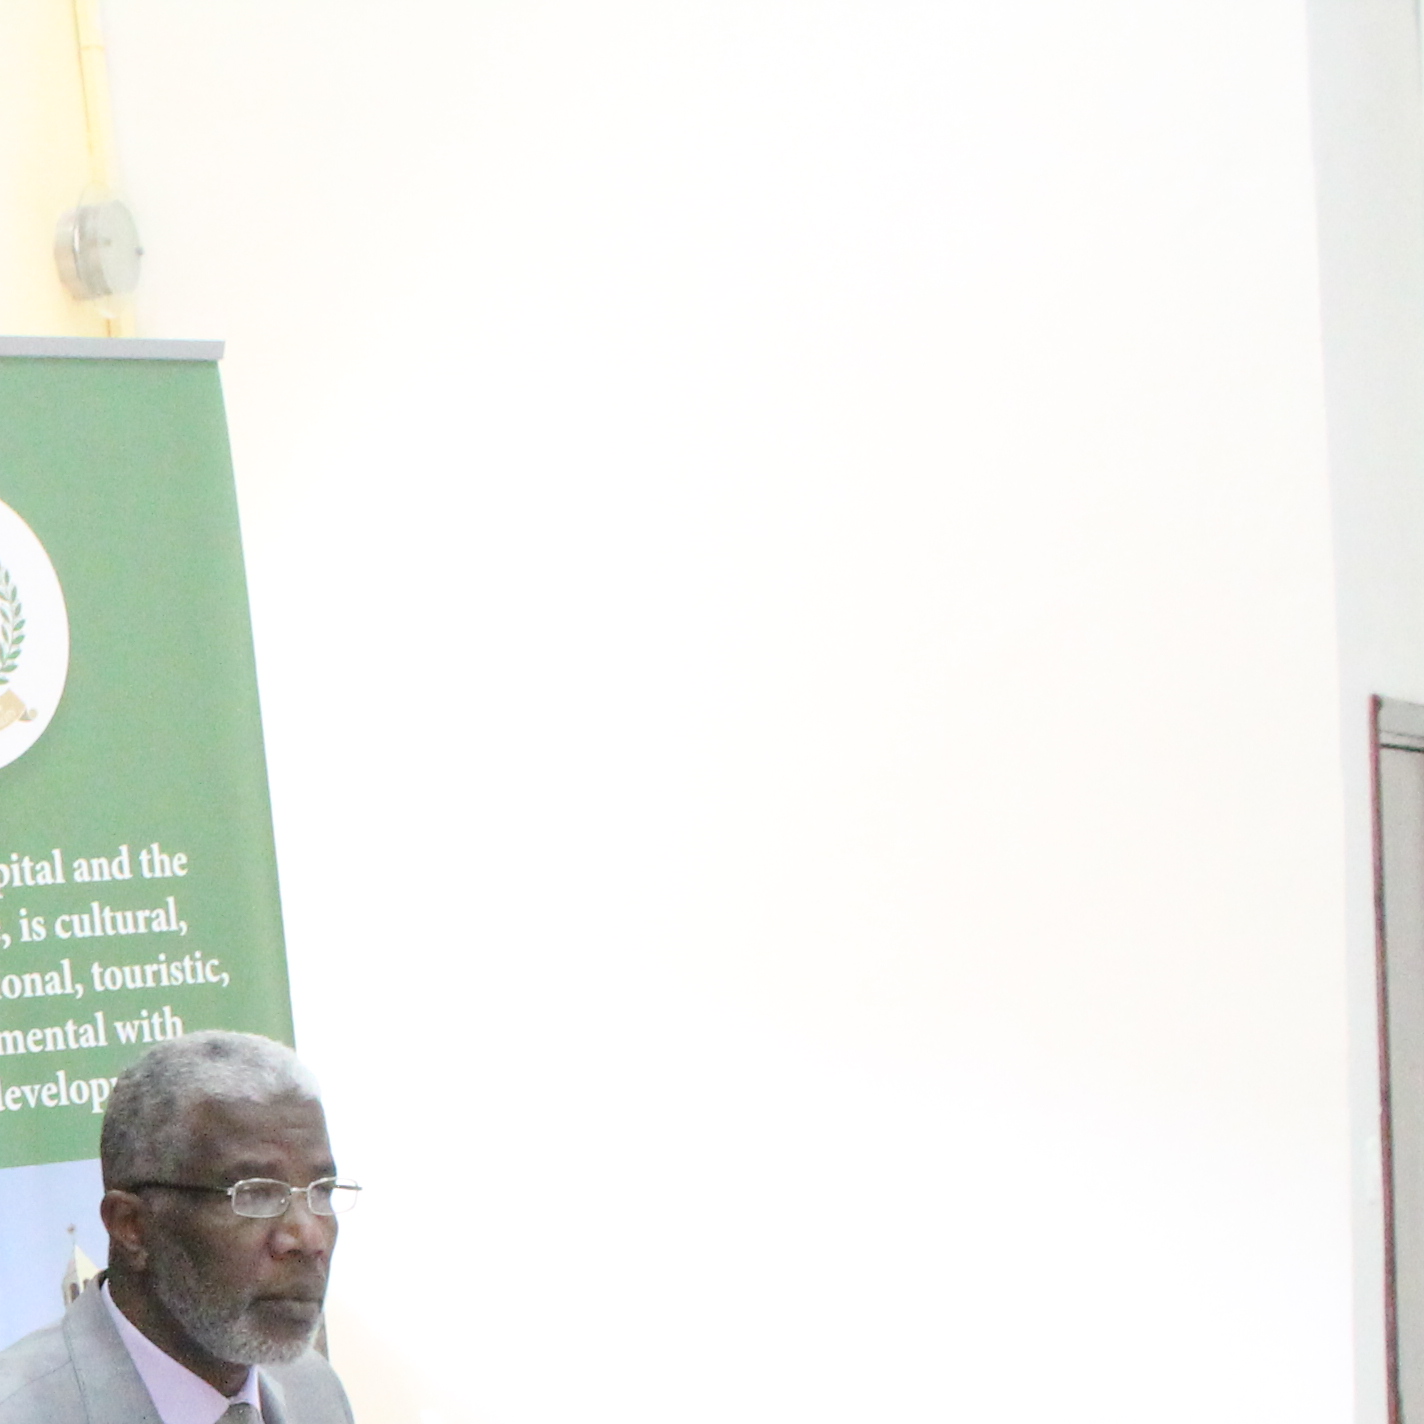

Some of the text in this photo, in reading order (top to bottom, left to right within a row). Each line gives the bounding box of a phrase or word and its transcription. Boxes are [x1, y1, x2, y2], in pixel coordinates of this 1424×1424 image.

[73, 844, 133, 883] and
[139, 842, 188, 879] the
[19, 908, 47, 942] is
[54, 896, 188, 939] cultural,
[91, 951, 230, 991] touristic,
[114, 1006, 184, 1045] with
